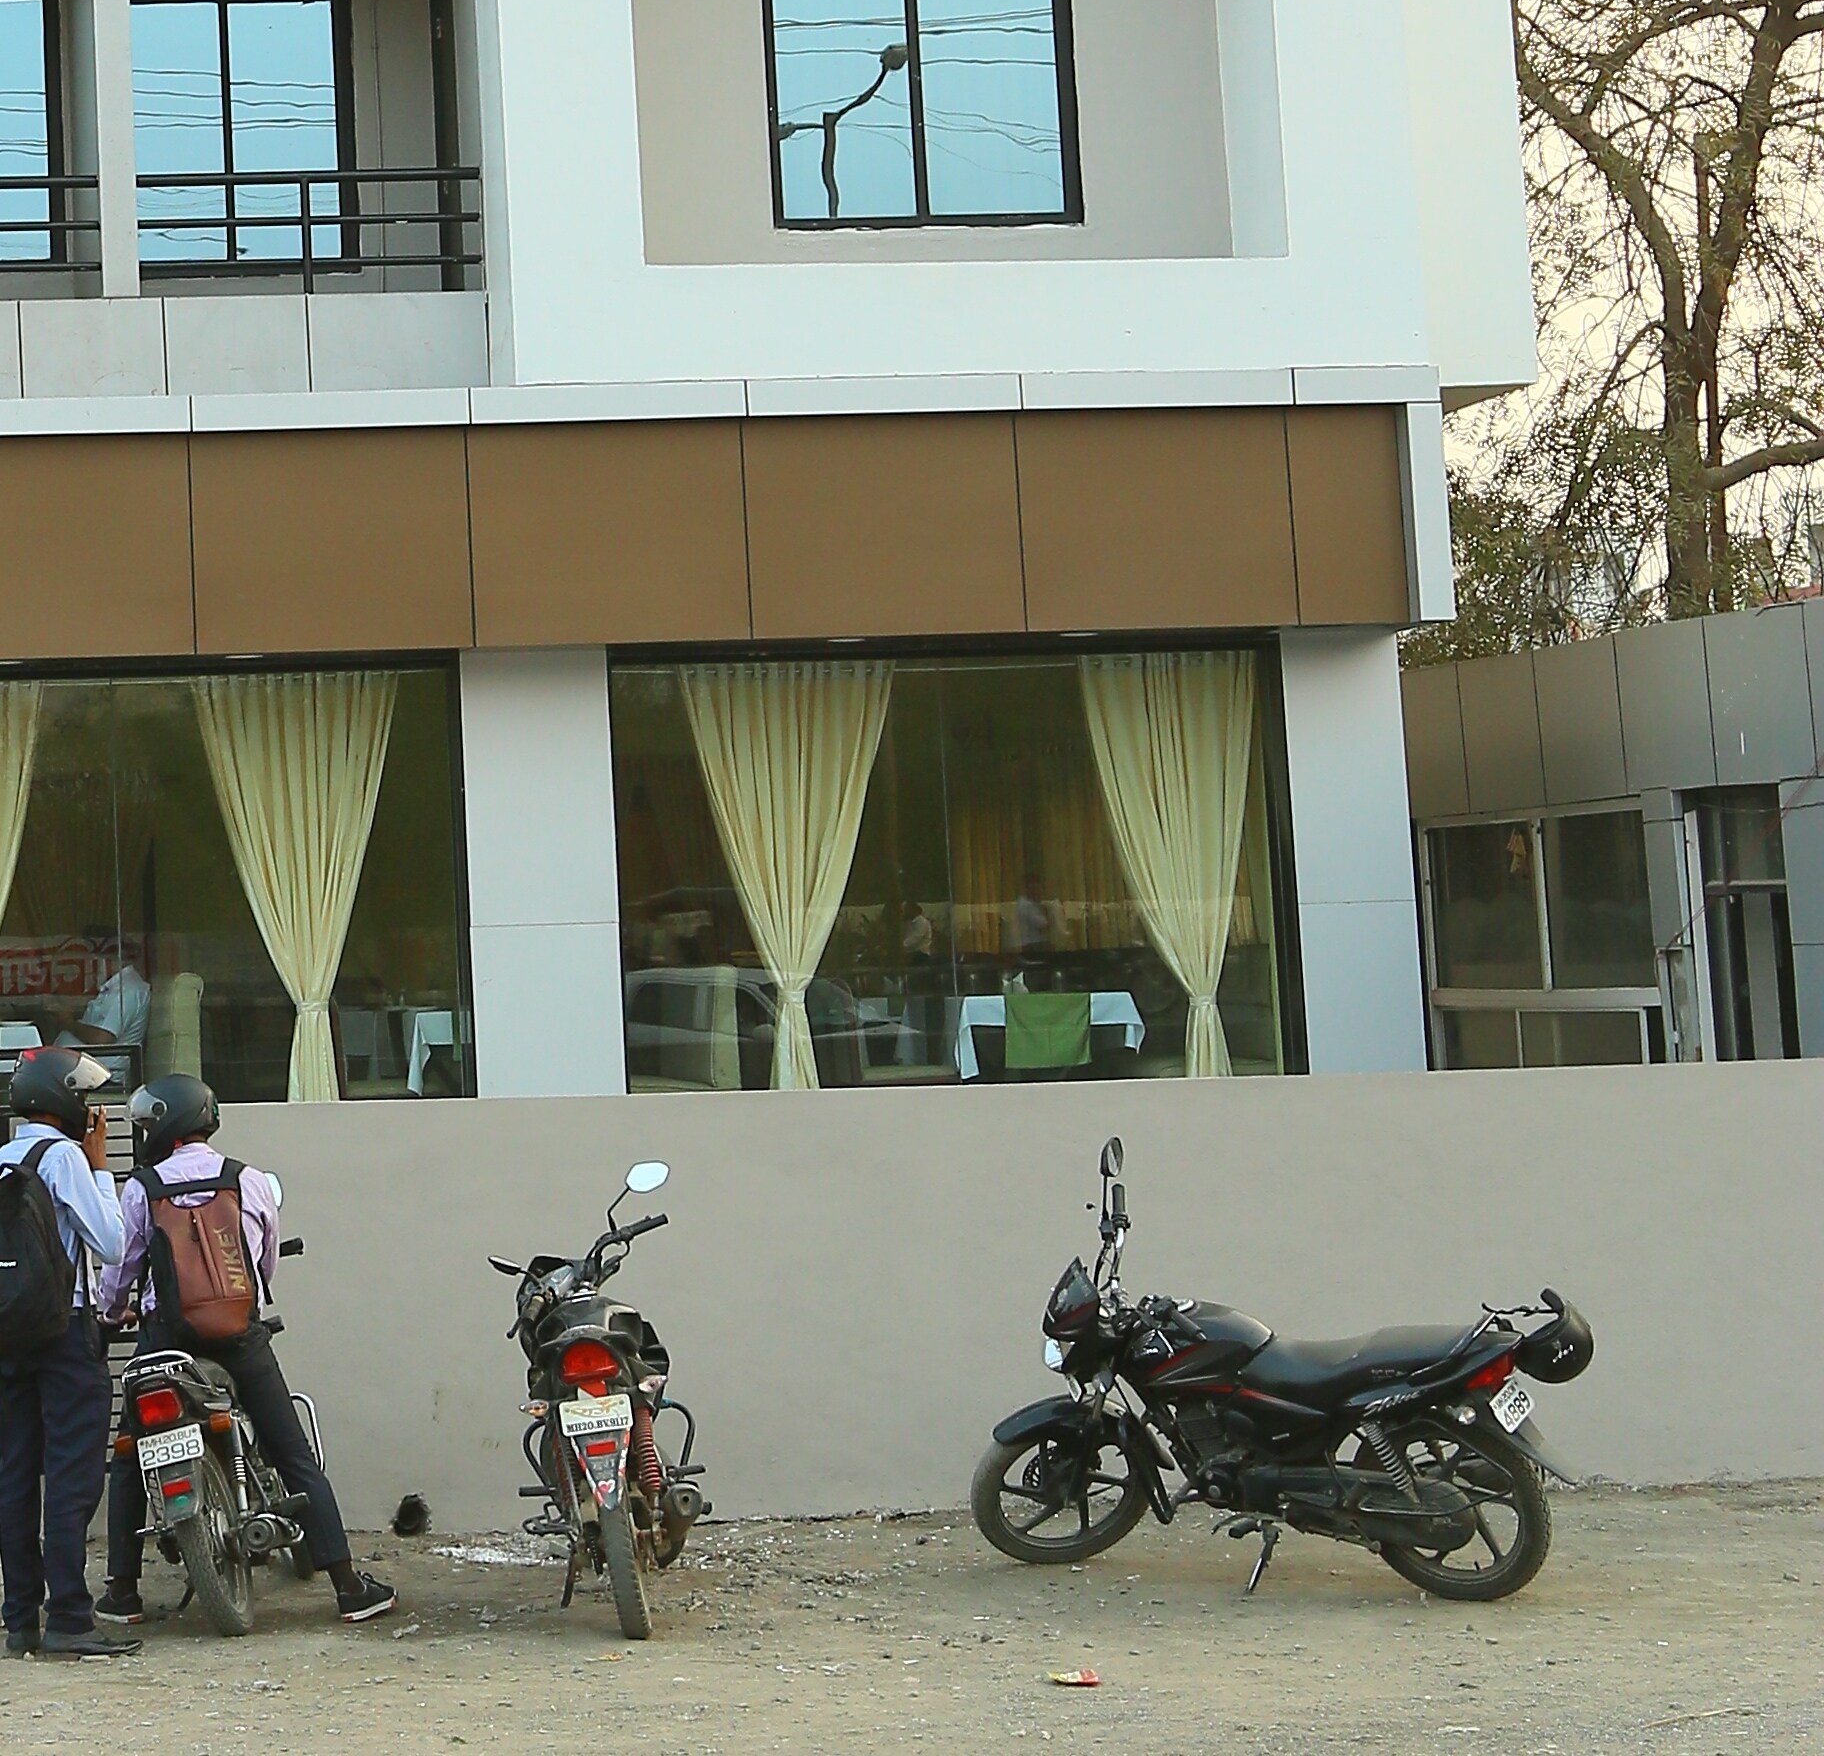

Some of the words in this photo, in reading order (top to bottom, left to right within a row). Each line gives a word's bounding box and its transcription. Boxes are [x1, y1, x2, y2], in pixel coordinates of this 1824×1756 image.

[217, 1233, 247, 1294] NIKE
[1503, 1390, 1531, 1427] 4889
[142, 1438, 201, 1467] 2398
